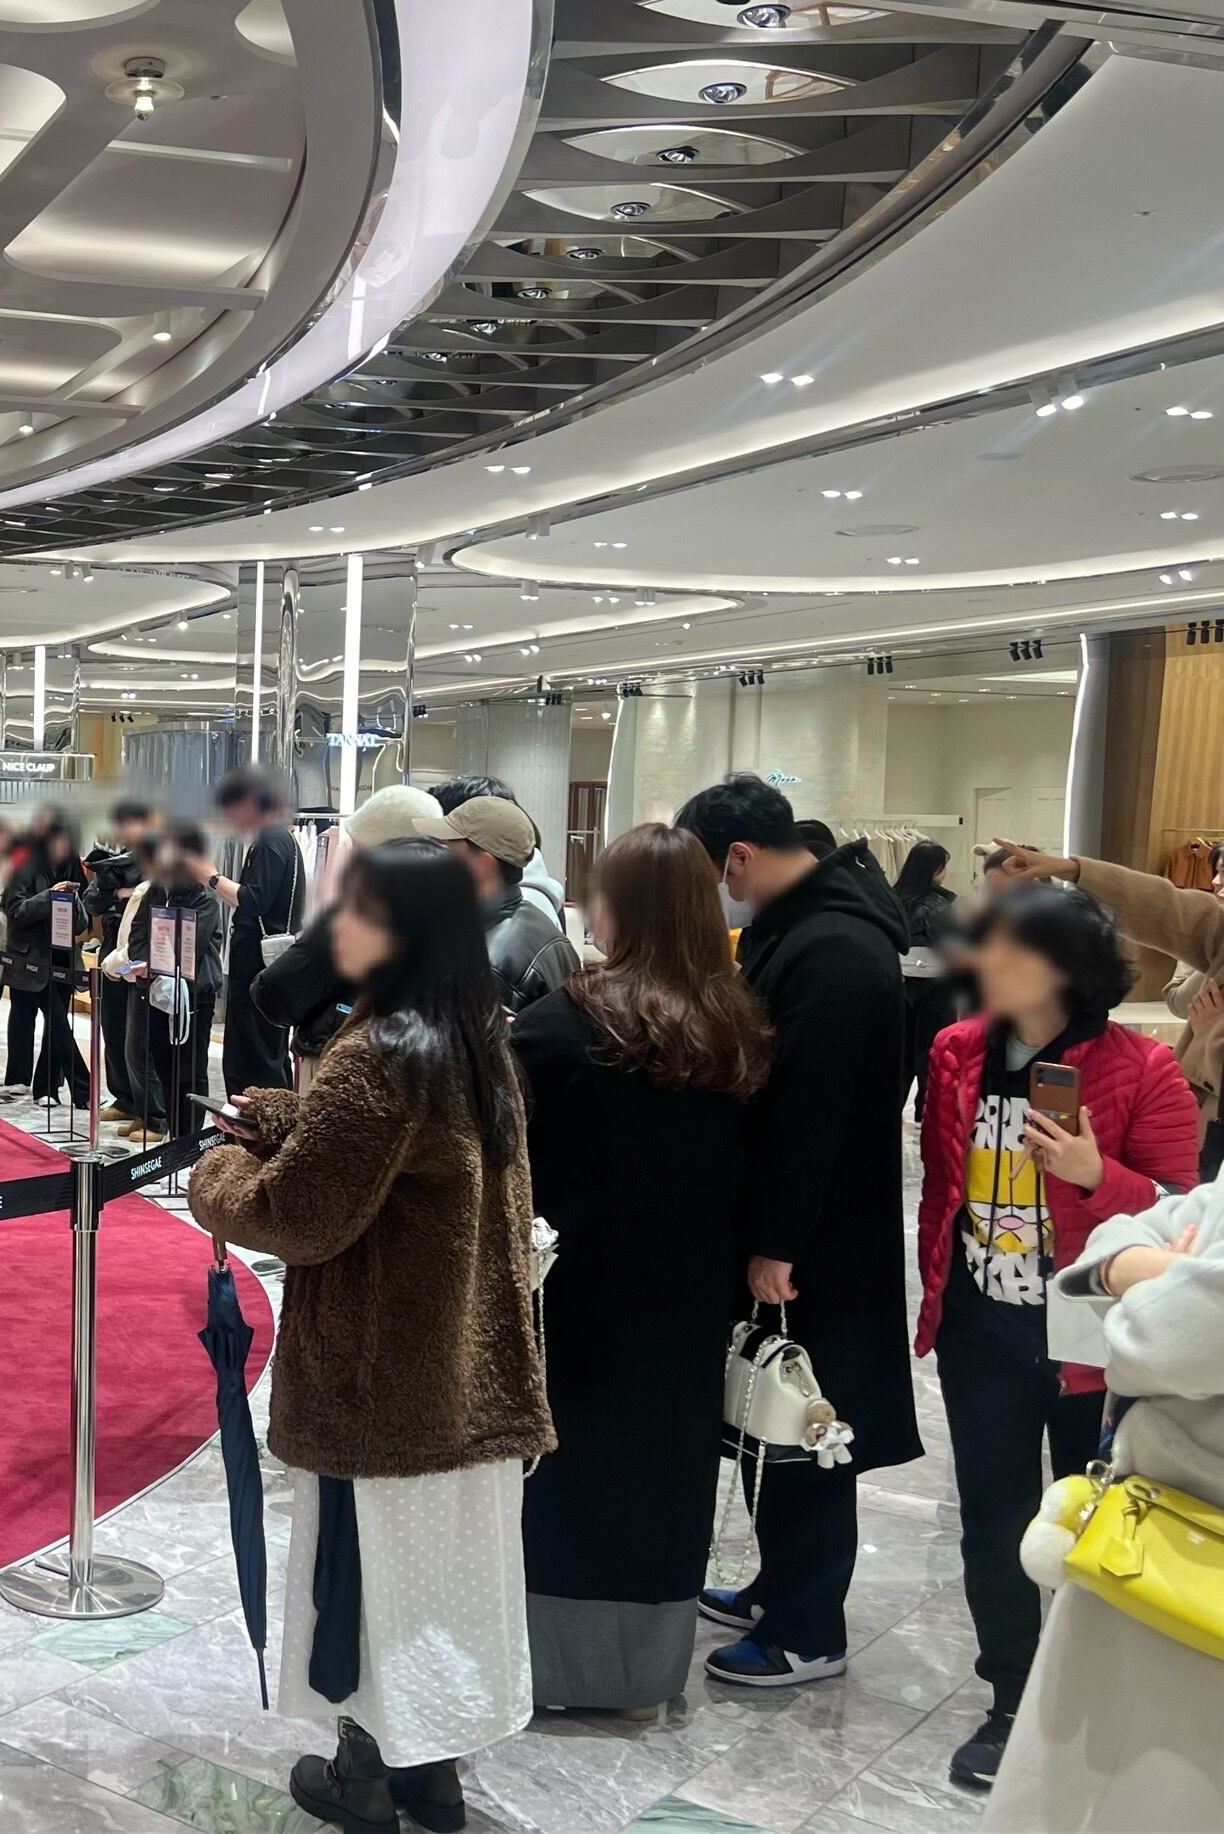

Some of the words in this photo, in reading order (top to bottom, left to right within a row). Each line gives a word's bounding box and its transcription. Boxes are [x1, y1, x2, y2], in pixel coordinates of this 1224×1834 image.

[2, 762, 25, 771] NICE
[26, 762, 55, 772] CLAUP
[130, 1156, 163, 1180] SHINSEGAE
